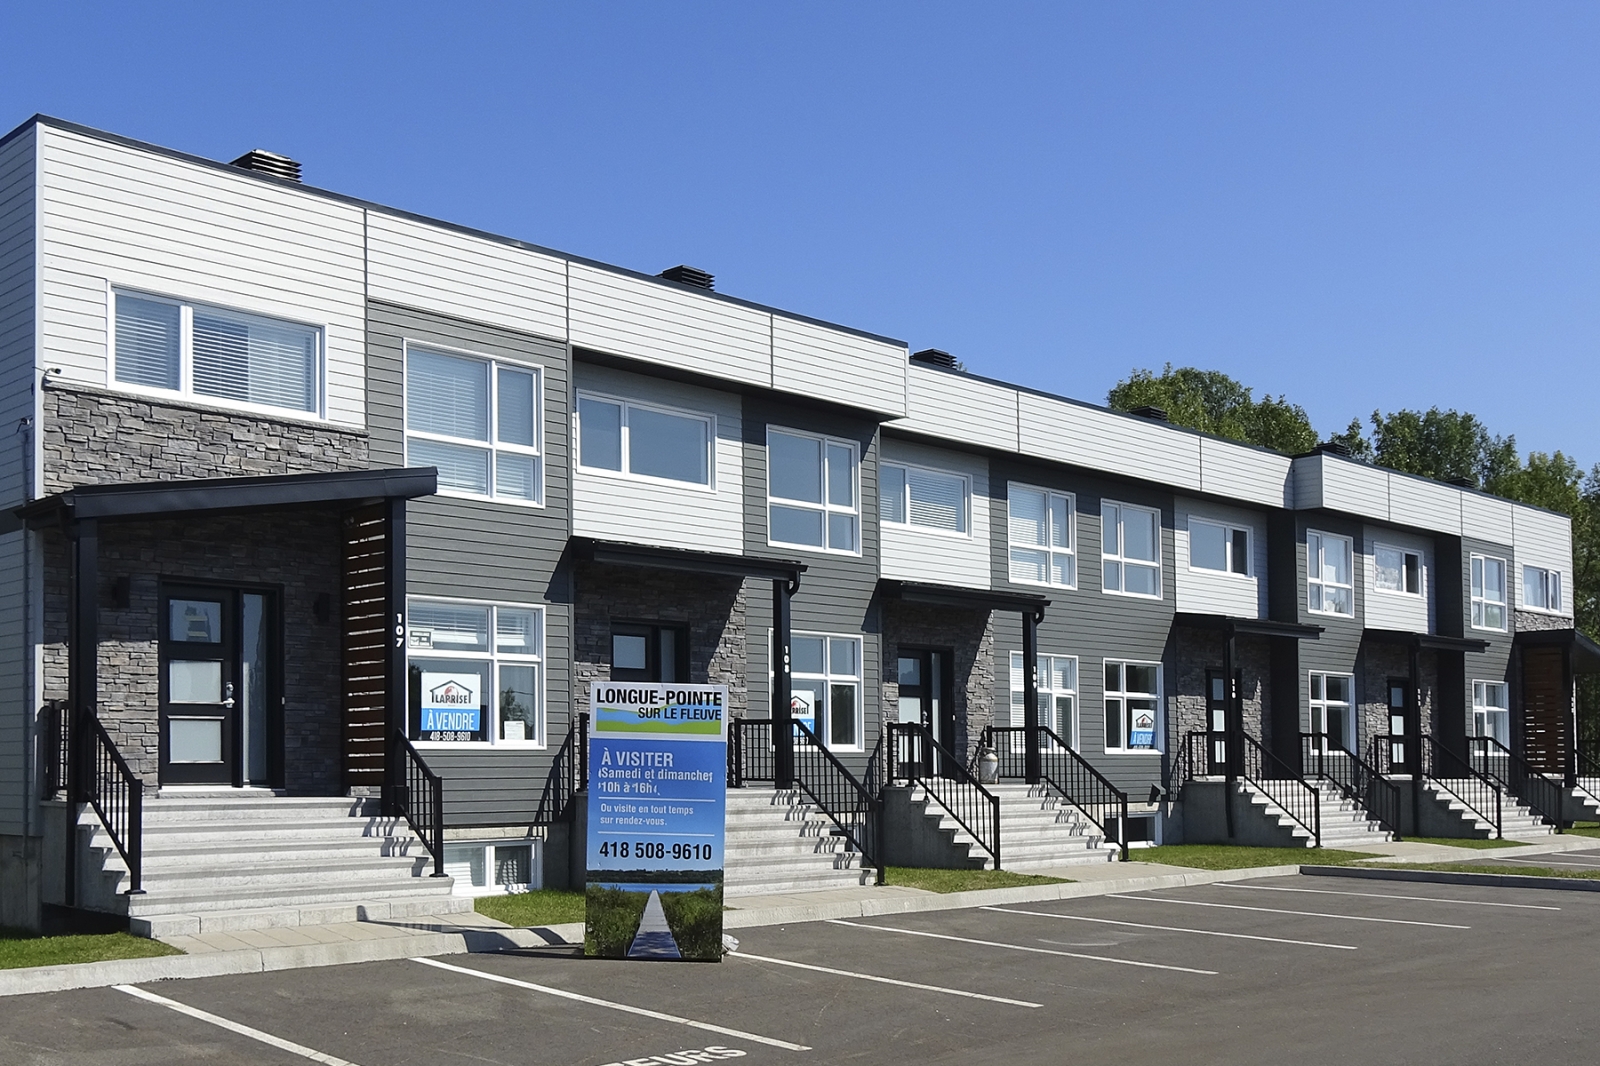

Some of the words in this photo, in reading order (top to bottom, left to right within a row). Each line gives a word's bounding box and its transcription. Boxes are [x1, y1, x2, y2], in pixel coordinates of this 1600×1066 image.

[396, 613, 404, 648] 107
[435, 694, 468, 704] LAPRISE
[596, 688, 722, 706] LONGUE-POINTE
[426, 709, 434, 731] À
[435, 712, 475, 731] VENDRE
[638, 707, 661, 719] SUR
[664, 708, 678, 719] LE
[680, 708, 722, 721] FLEUVE
[430, 731, 471, 741] 418-508-9610
[601, 747, 612, 766] À
[616, 751, 674, 768] VISITER
[601, 767, 641, 779] Samedi
[645, 769, 655, 780] et
[602, 781, 620, 793] 10h
[623, 782, 631, 793] à
[634, 782, 653, 794] 16h
[601, 803, 612, 813] Ou
[614, 803, 637, 814] visite
[639, 805, 649, 814] en
[651, 805, 667, 815] tout
[669, 806, 694, 817] temps
[600, 816, 614, 825] sur
[616, 816, 668, 827] rendez-vous.
[600, 841, 630, 859] 418
[635, 842, 713, 861] 508-9610
